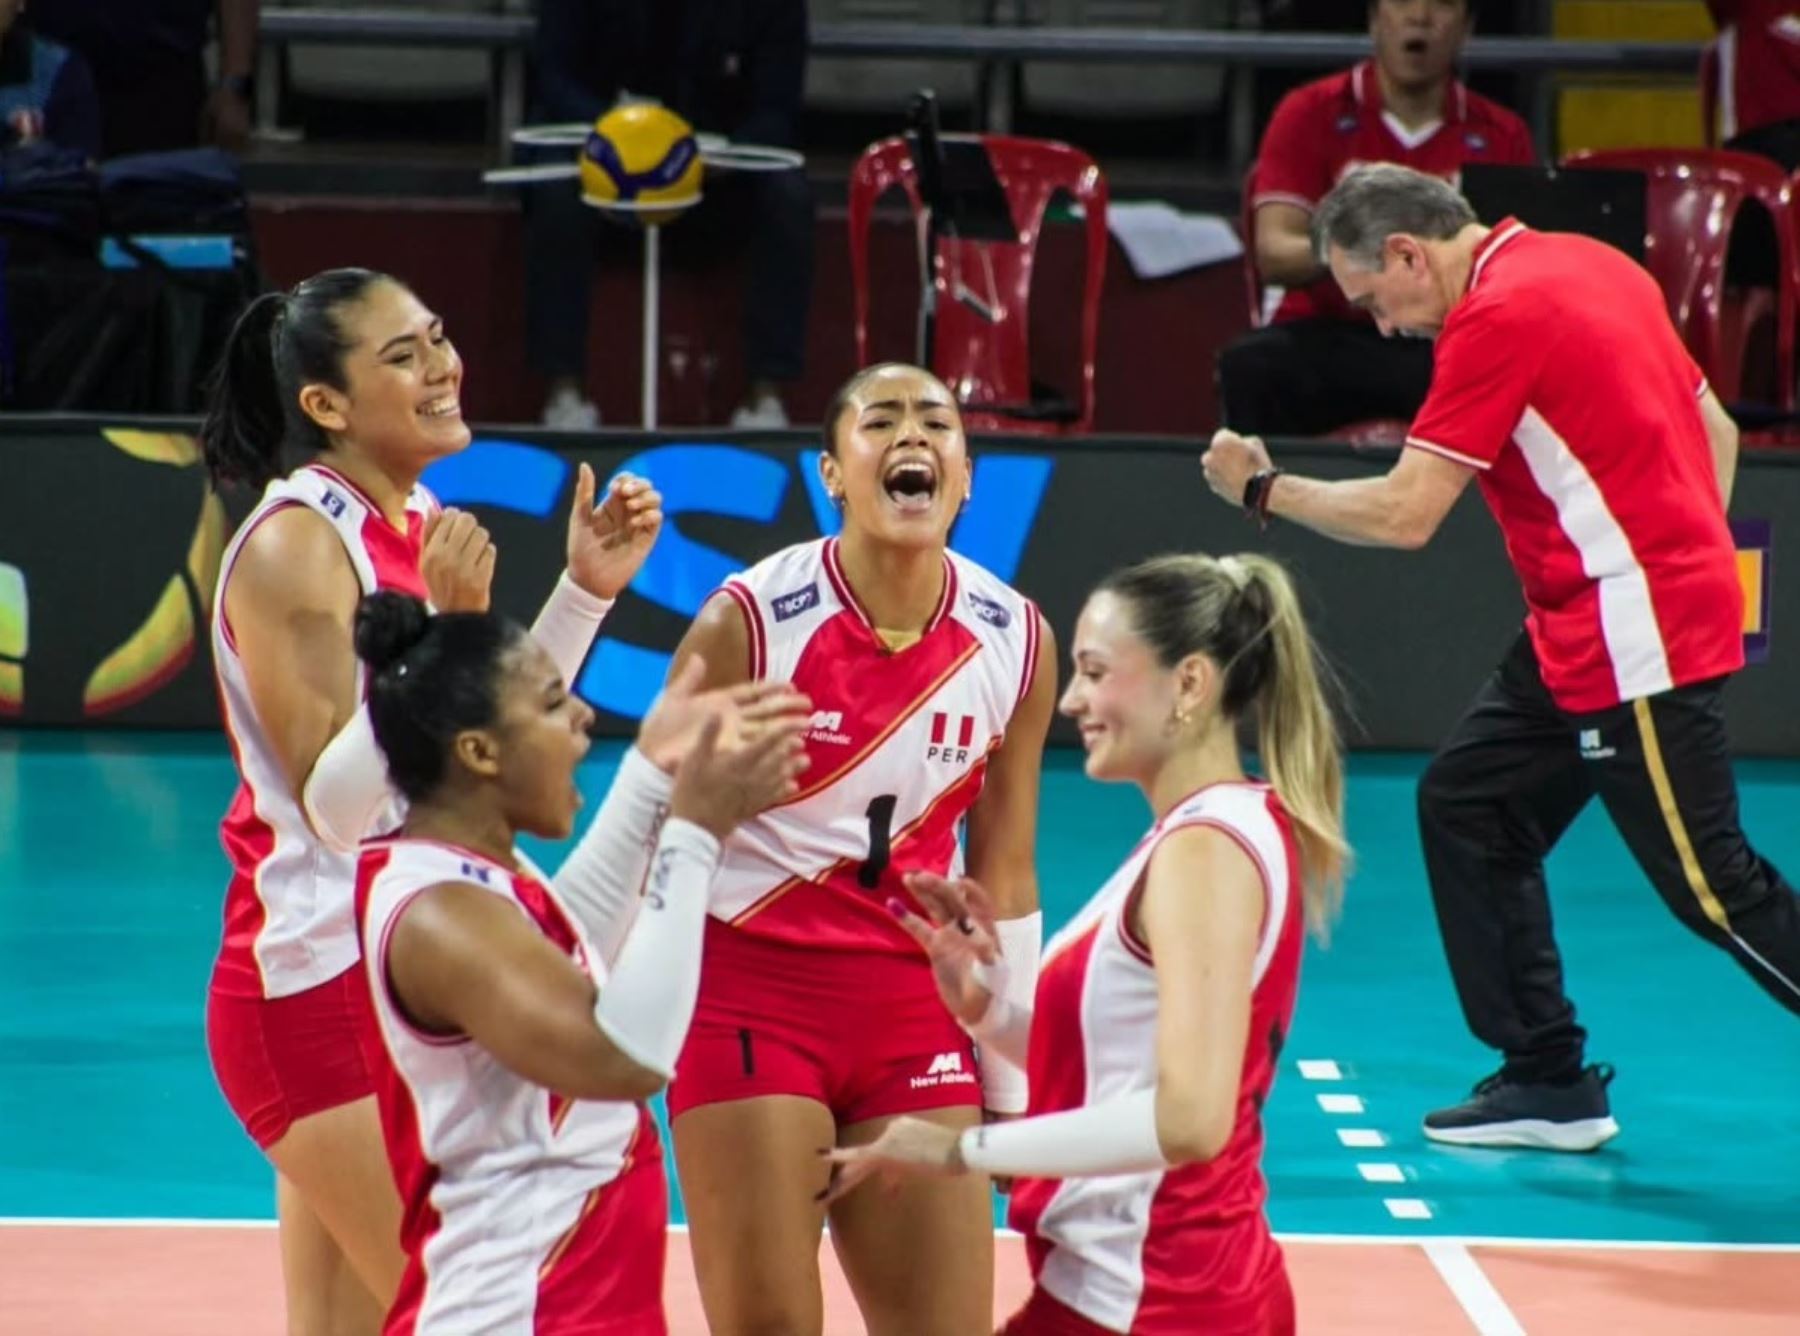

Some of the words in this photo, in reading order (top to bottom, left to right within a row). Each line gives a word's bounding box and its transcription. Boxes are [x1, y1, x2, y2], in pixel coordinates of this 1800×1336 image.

[927, 746, 969, 764] PER
[857, 793, 898, 890] 1
[738, 1027, 755, 1078] 1
[910, 1075, 939, 1090] New
